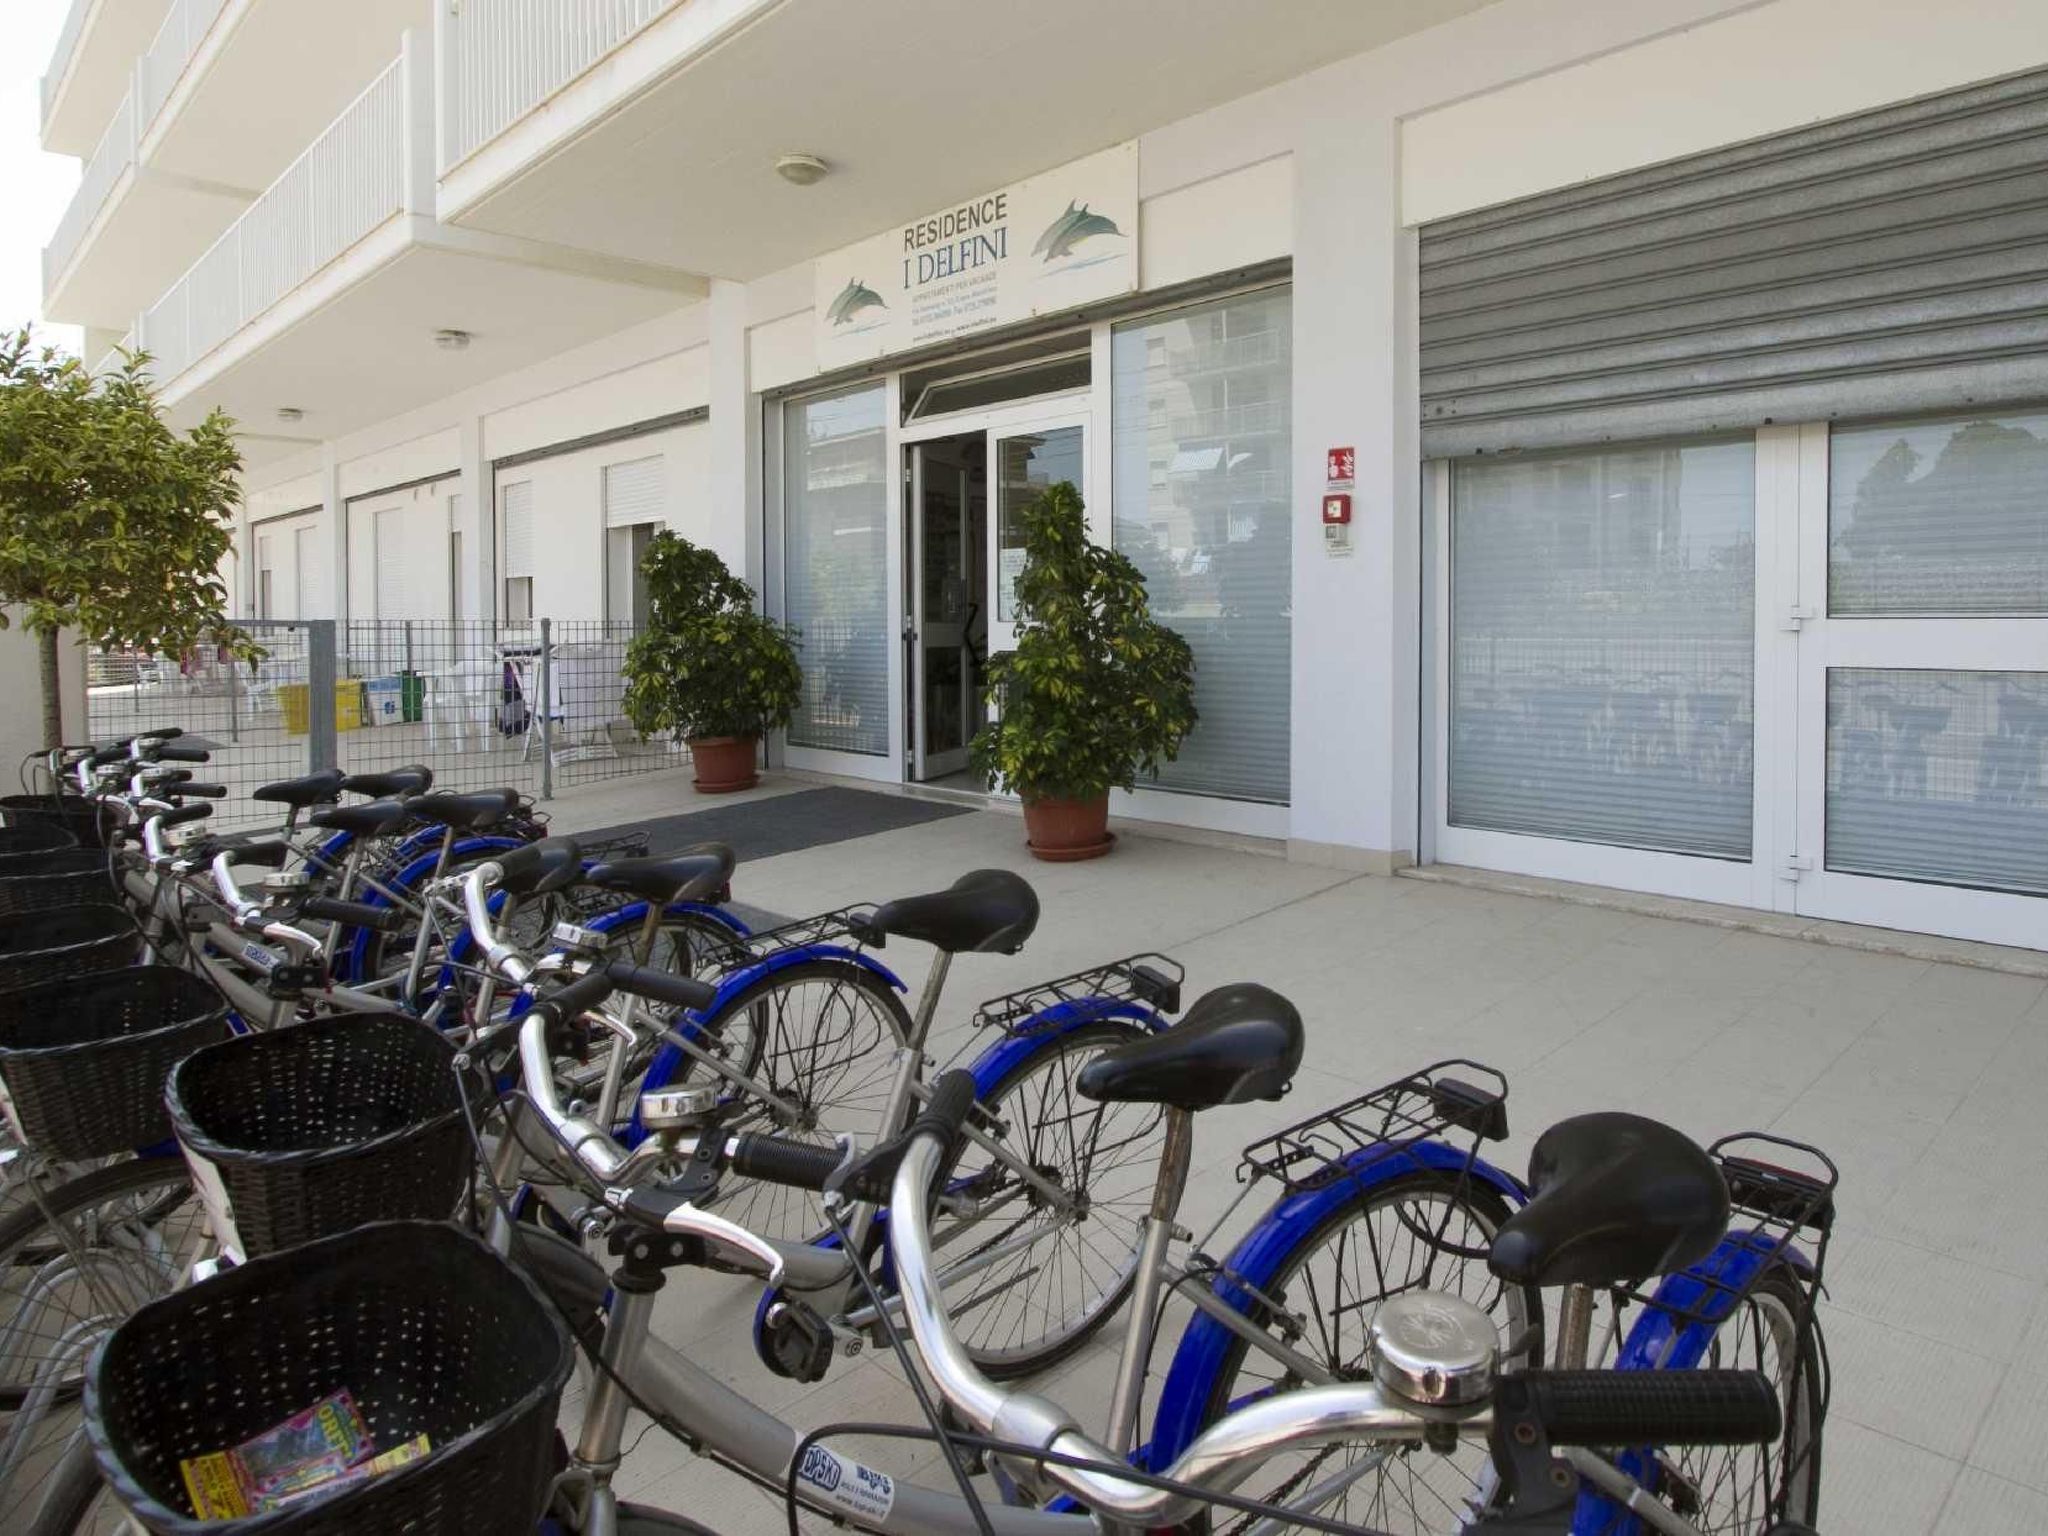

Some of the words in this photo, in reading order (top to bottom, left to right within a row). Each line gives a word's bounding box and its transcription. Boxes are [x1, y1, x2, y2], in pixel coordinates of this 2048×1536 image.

[904, 193, 1007, 252] RESIDENCE
[903, 259, 911, 289] I
[918, 226, 1008, 285] DELFINI
